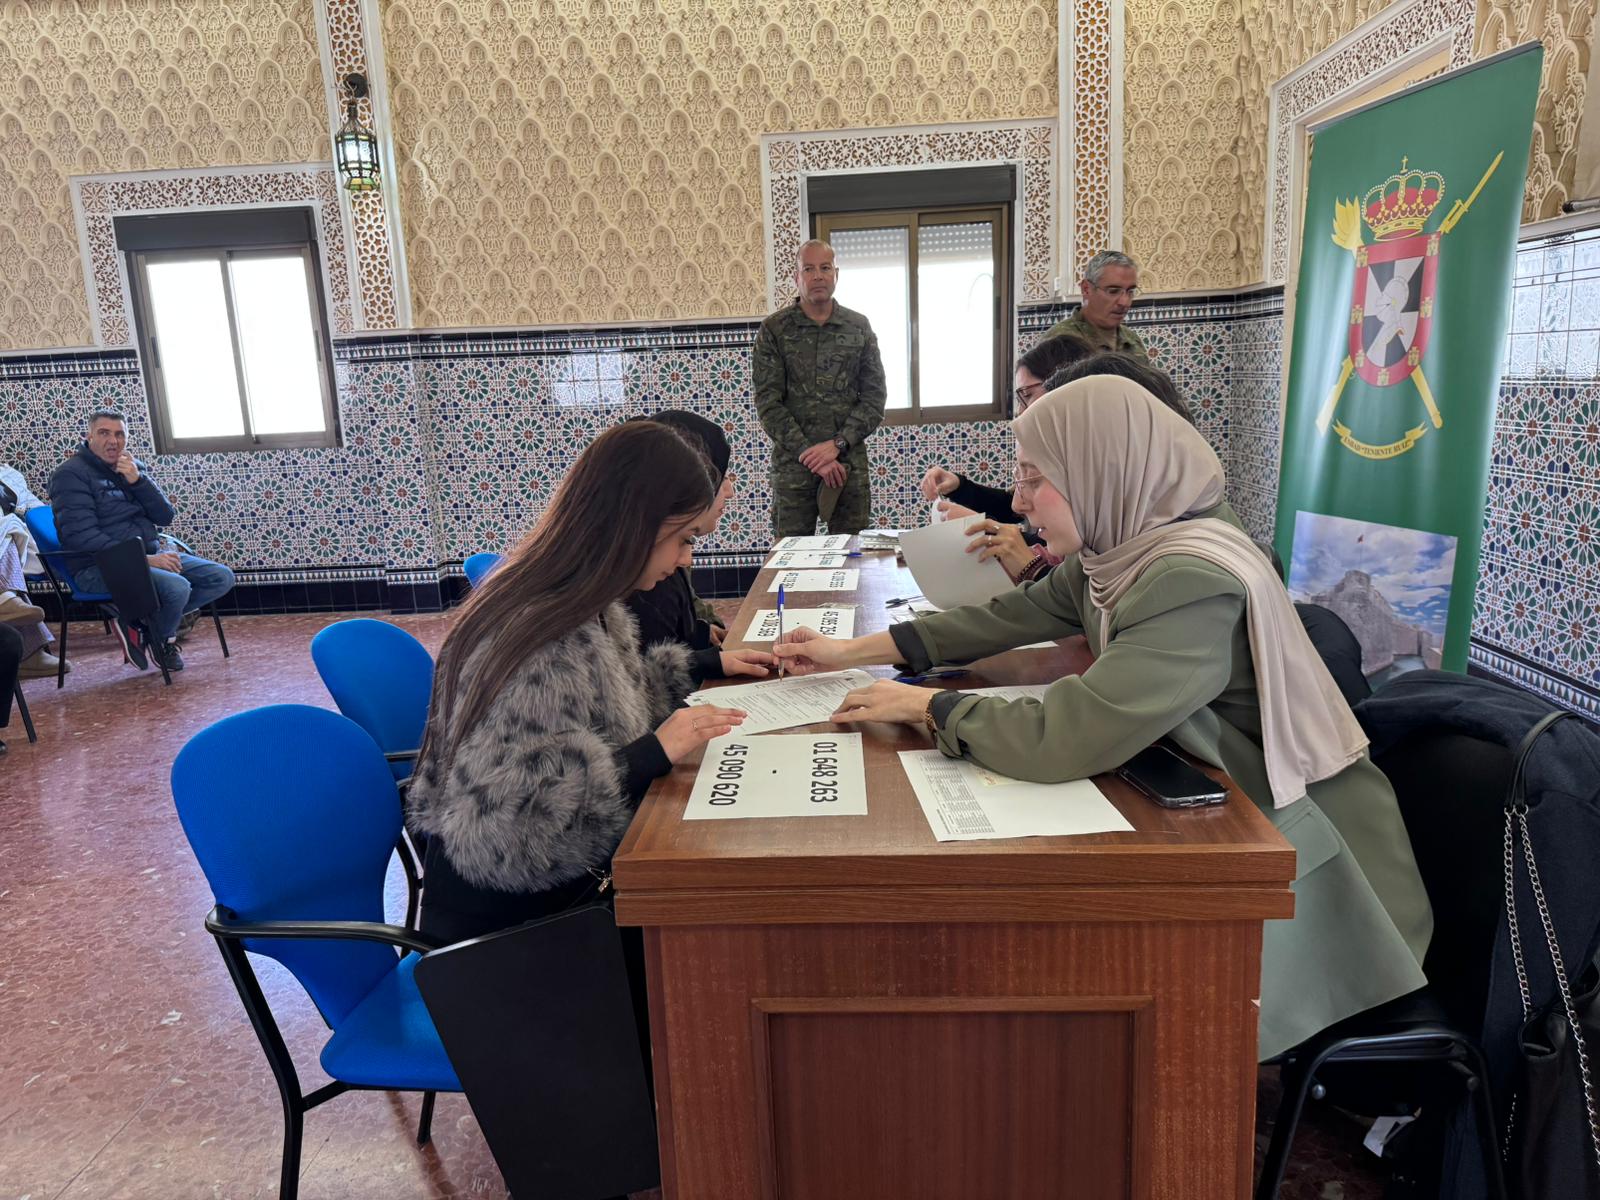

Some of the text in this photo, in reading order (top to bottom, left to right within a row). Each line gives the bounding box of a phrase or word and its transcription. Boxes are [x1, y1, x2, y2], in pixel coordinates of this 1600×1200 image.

[708, 743, 749, 806] 45 090 620
[810, 741, 838, 803] 01 648 263
